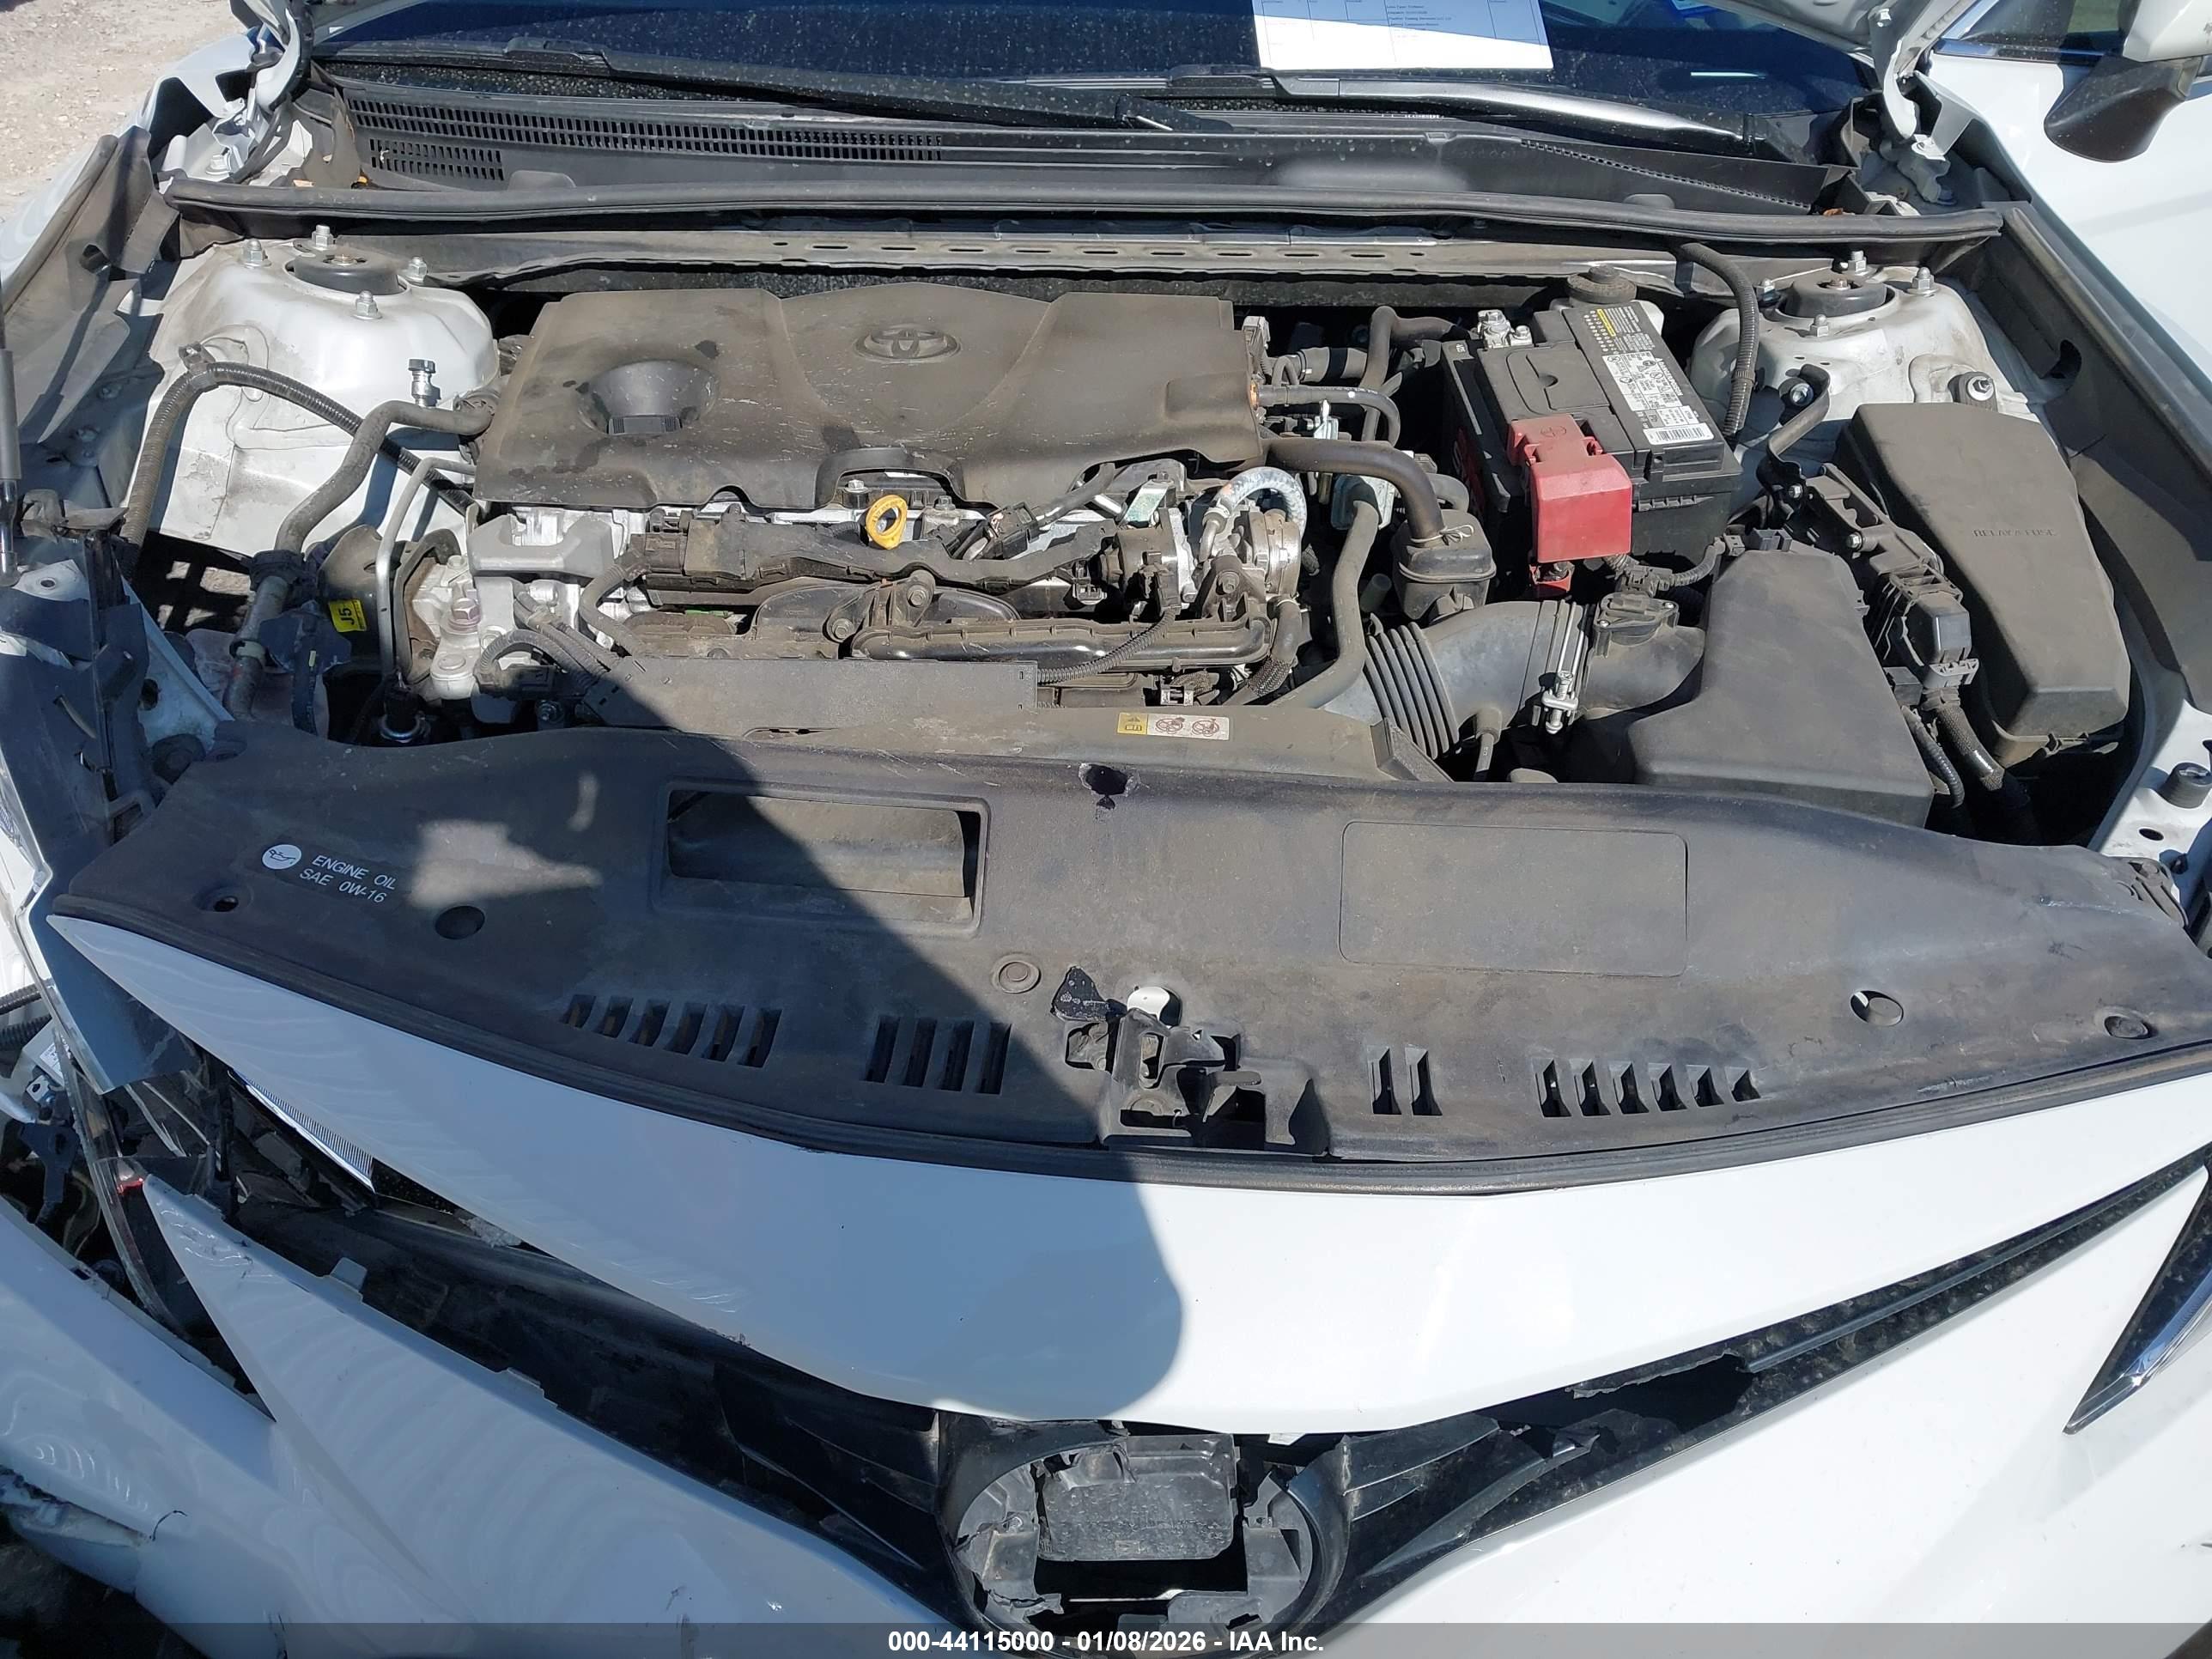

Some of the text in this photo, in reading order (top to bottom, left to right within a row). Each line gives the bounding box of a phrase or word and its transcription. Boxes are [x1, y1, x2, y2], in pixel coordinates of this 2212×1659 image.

[338, 608, 355, 625] J5
[299, 868, 387, 903] SAE 0W-16
[312, 854, 397, 890] ENGINE OIL
